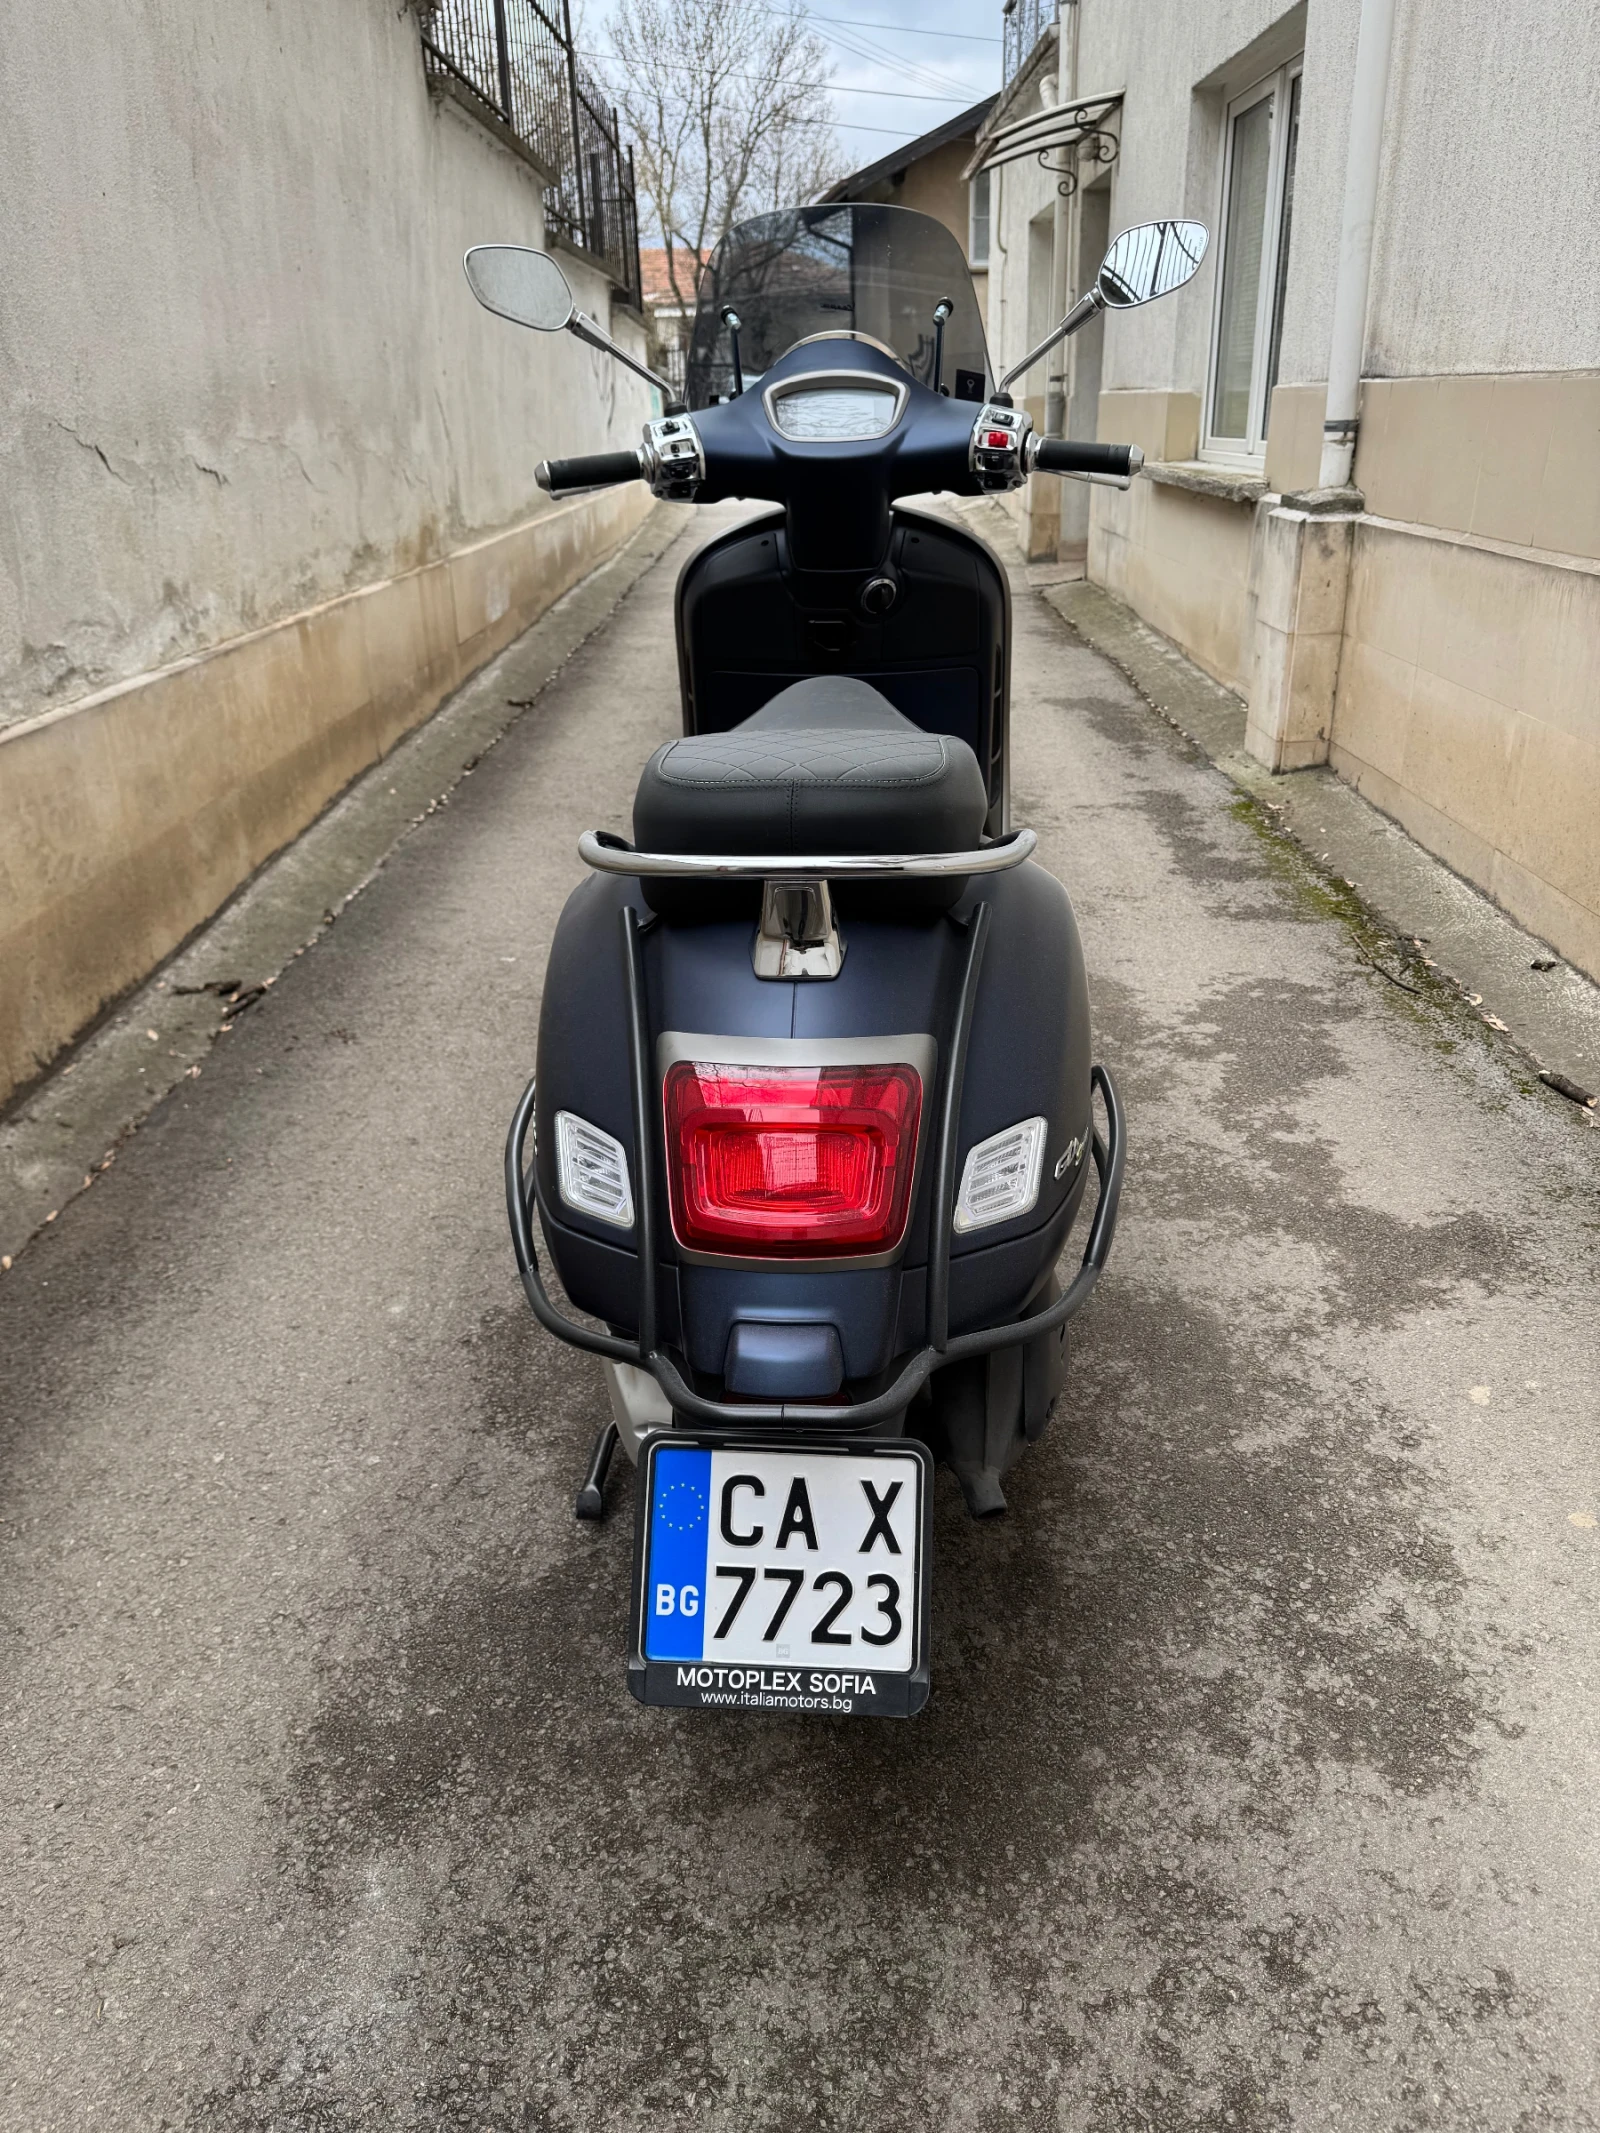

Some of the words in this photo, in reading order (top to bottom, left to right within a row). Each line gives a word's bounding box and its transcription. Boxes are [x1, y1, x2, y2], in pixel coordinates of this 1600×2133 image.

[720, 1475, 819, 1550] CA
[858, 1480, 904, 1554] X
[655, 1583, 699, 1617] BG
[713, 1566, 904, 1646] 7723
[677, 1667, 802, 1692] MOTOPLEX
[809, 1673, 877, 1695] SOFIA
[700, 1691, 853, 1713] www.italiamotors.bg
